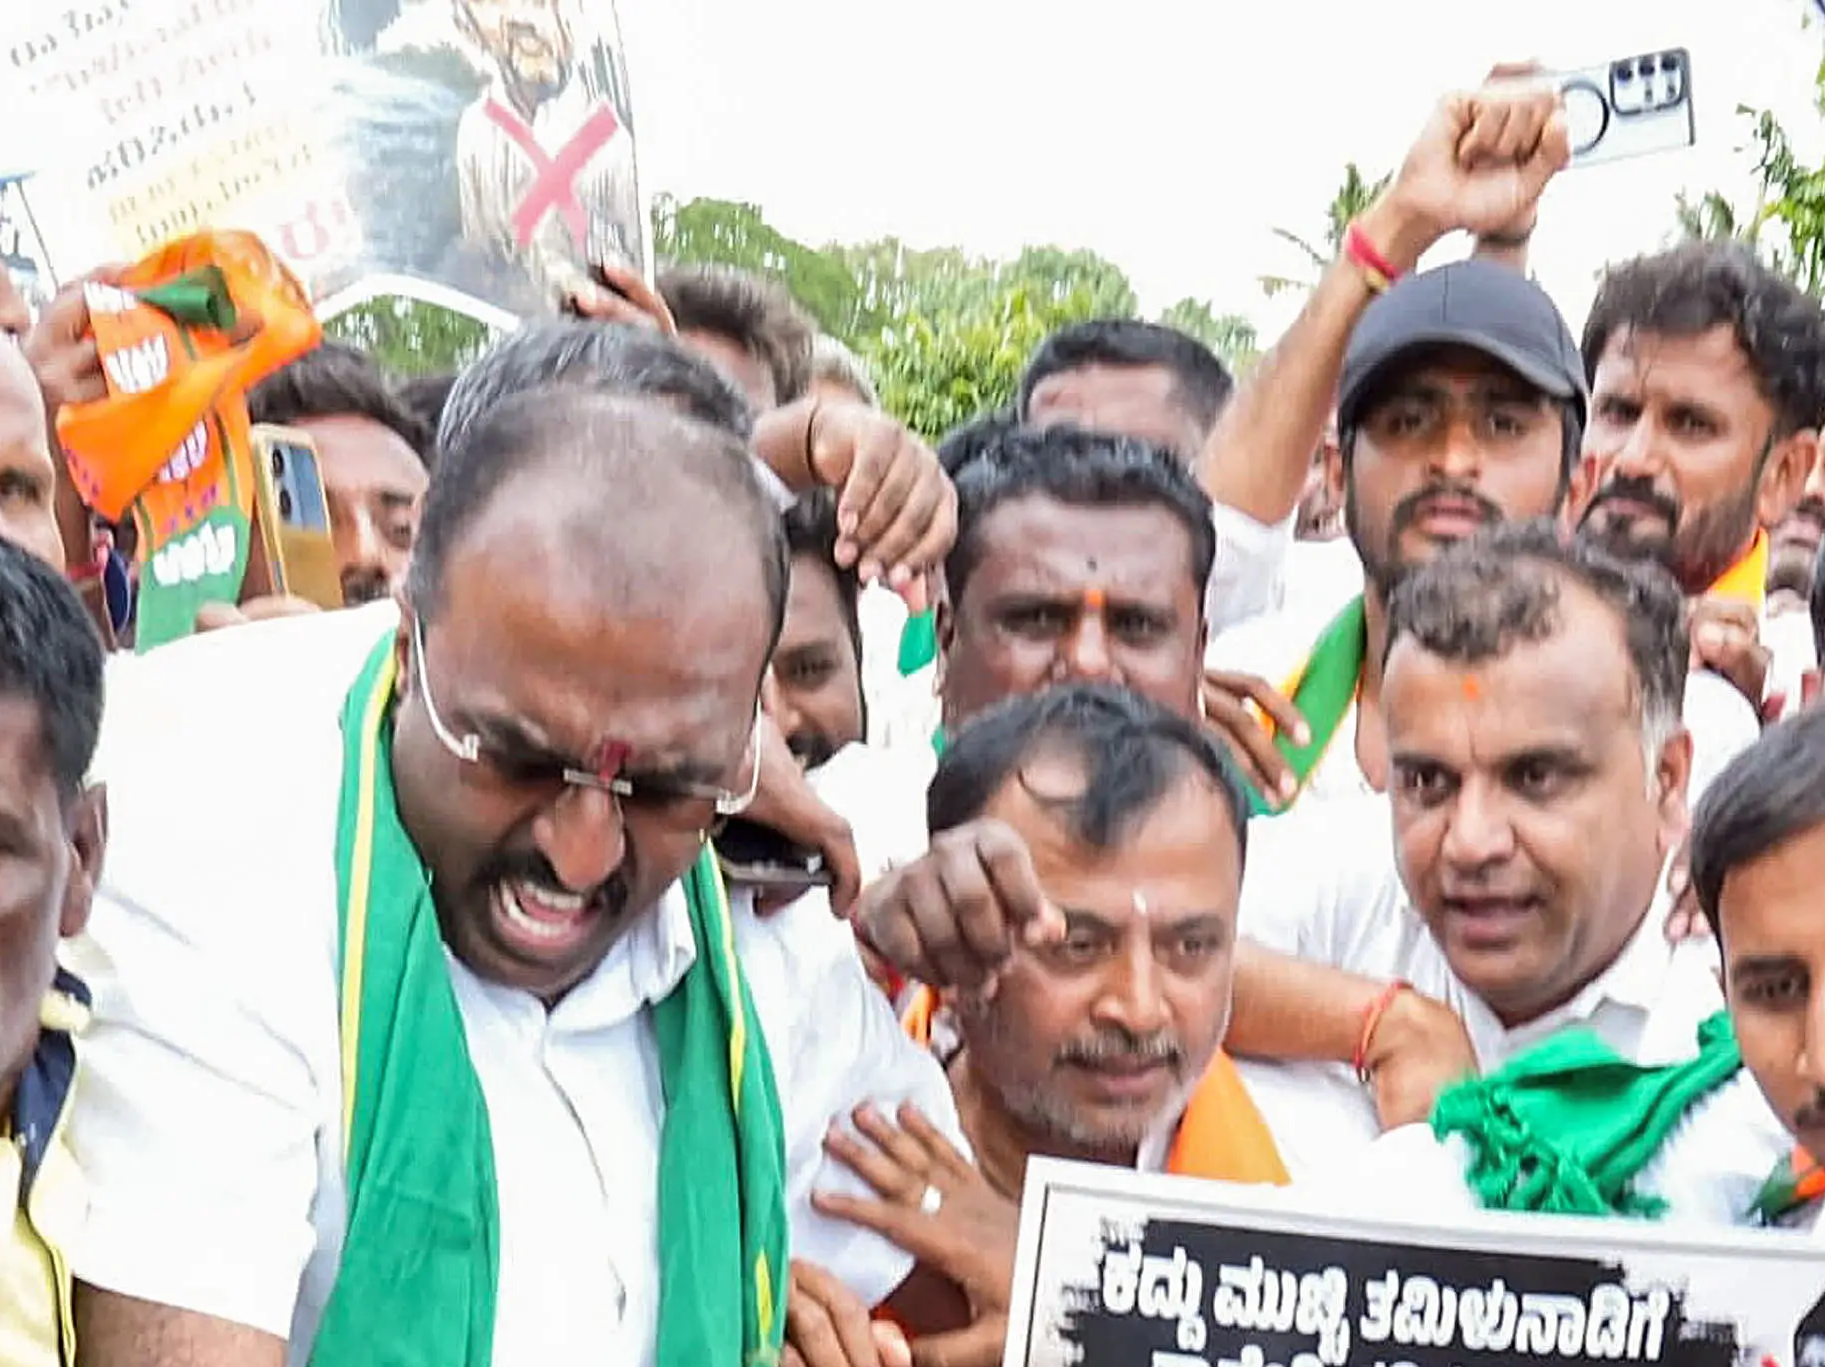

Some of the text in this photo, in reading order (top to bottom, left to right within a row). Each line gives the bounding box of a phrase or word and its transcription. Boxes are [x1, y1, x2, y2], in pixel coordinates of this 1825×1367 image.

[1101, 1241, 1678, 1366] ಕದ್ದು ಮುಚ್ಚಿ ತಮಿಳುನಾಡಿಗೆ
